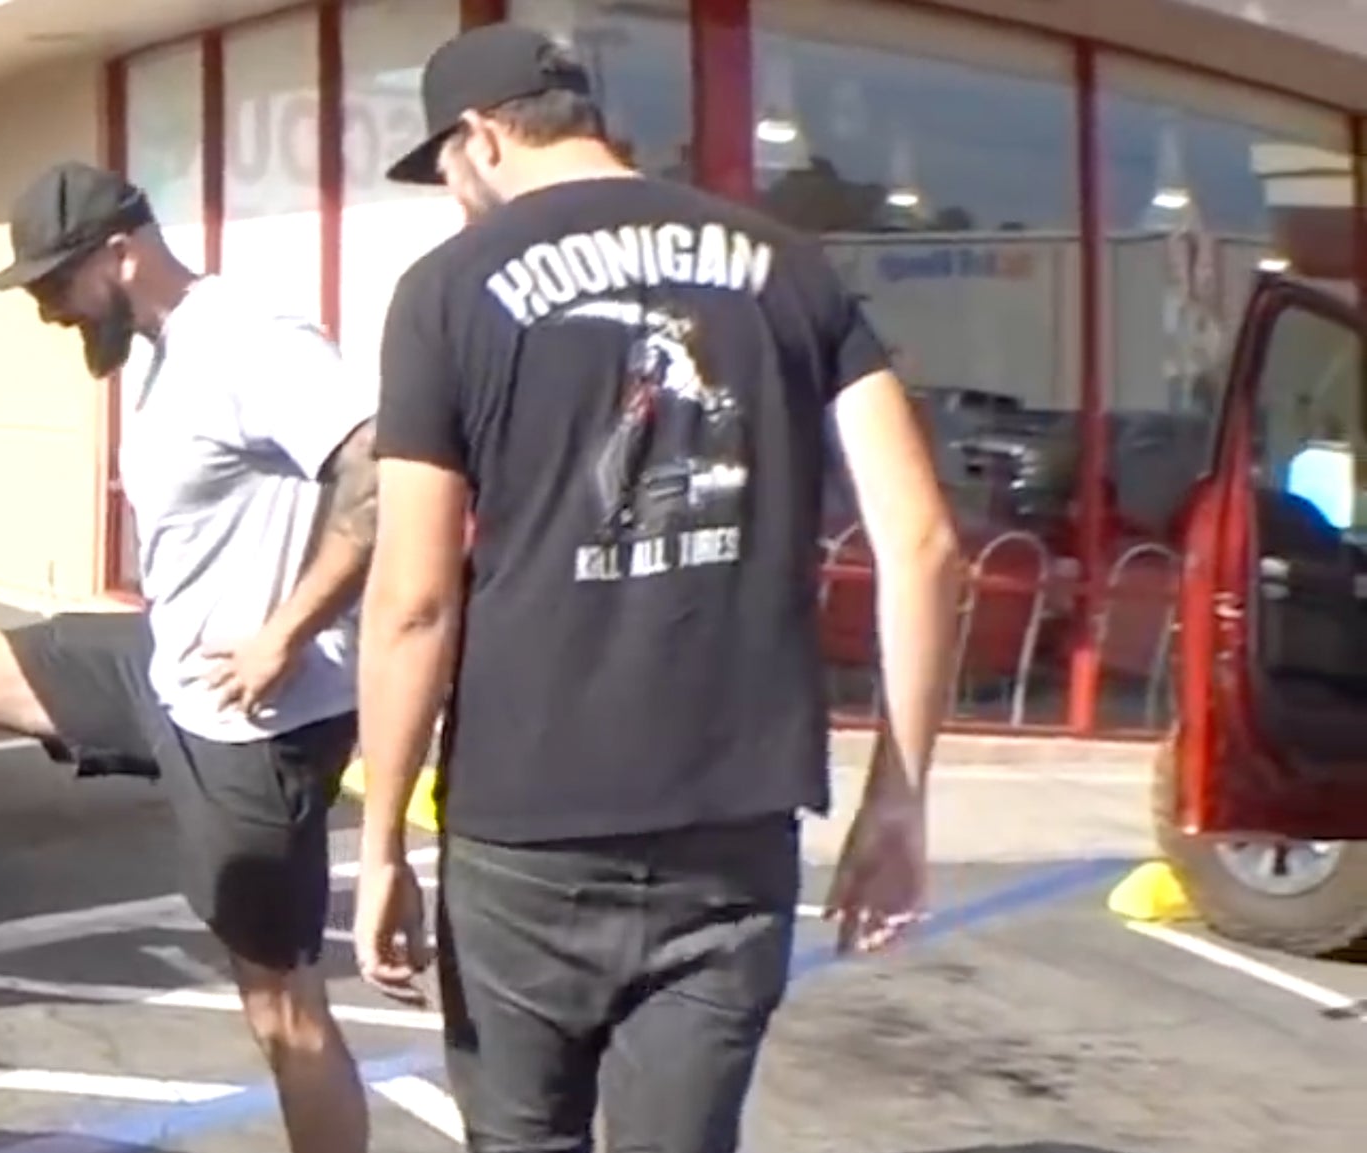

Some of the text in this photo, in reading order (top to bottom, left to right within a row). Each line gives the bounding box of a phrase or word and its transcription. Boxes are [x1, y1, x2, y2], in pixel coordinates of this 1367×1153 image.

[486, 222, 772, 325] HOONIGAN
[575, 526, 741, 582] KILL ALL TIRES
